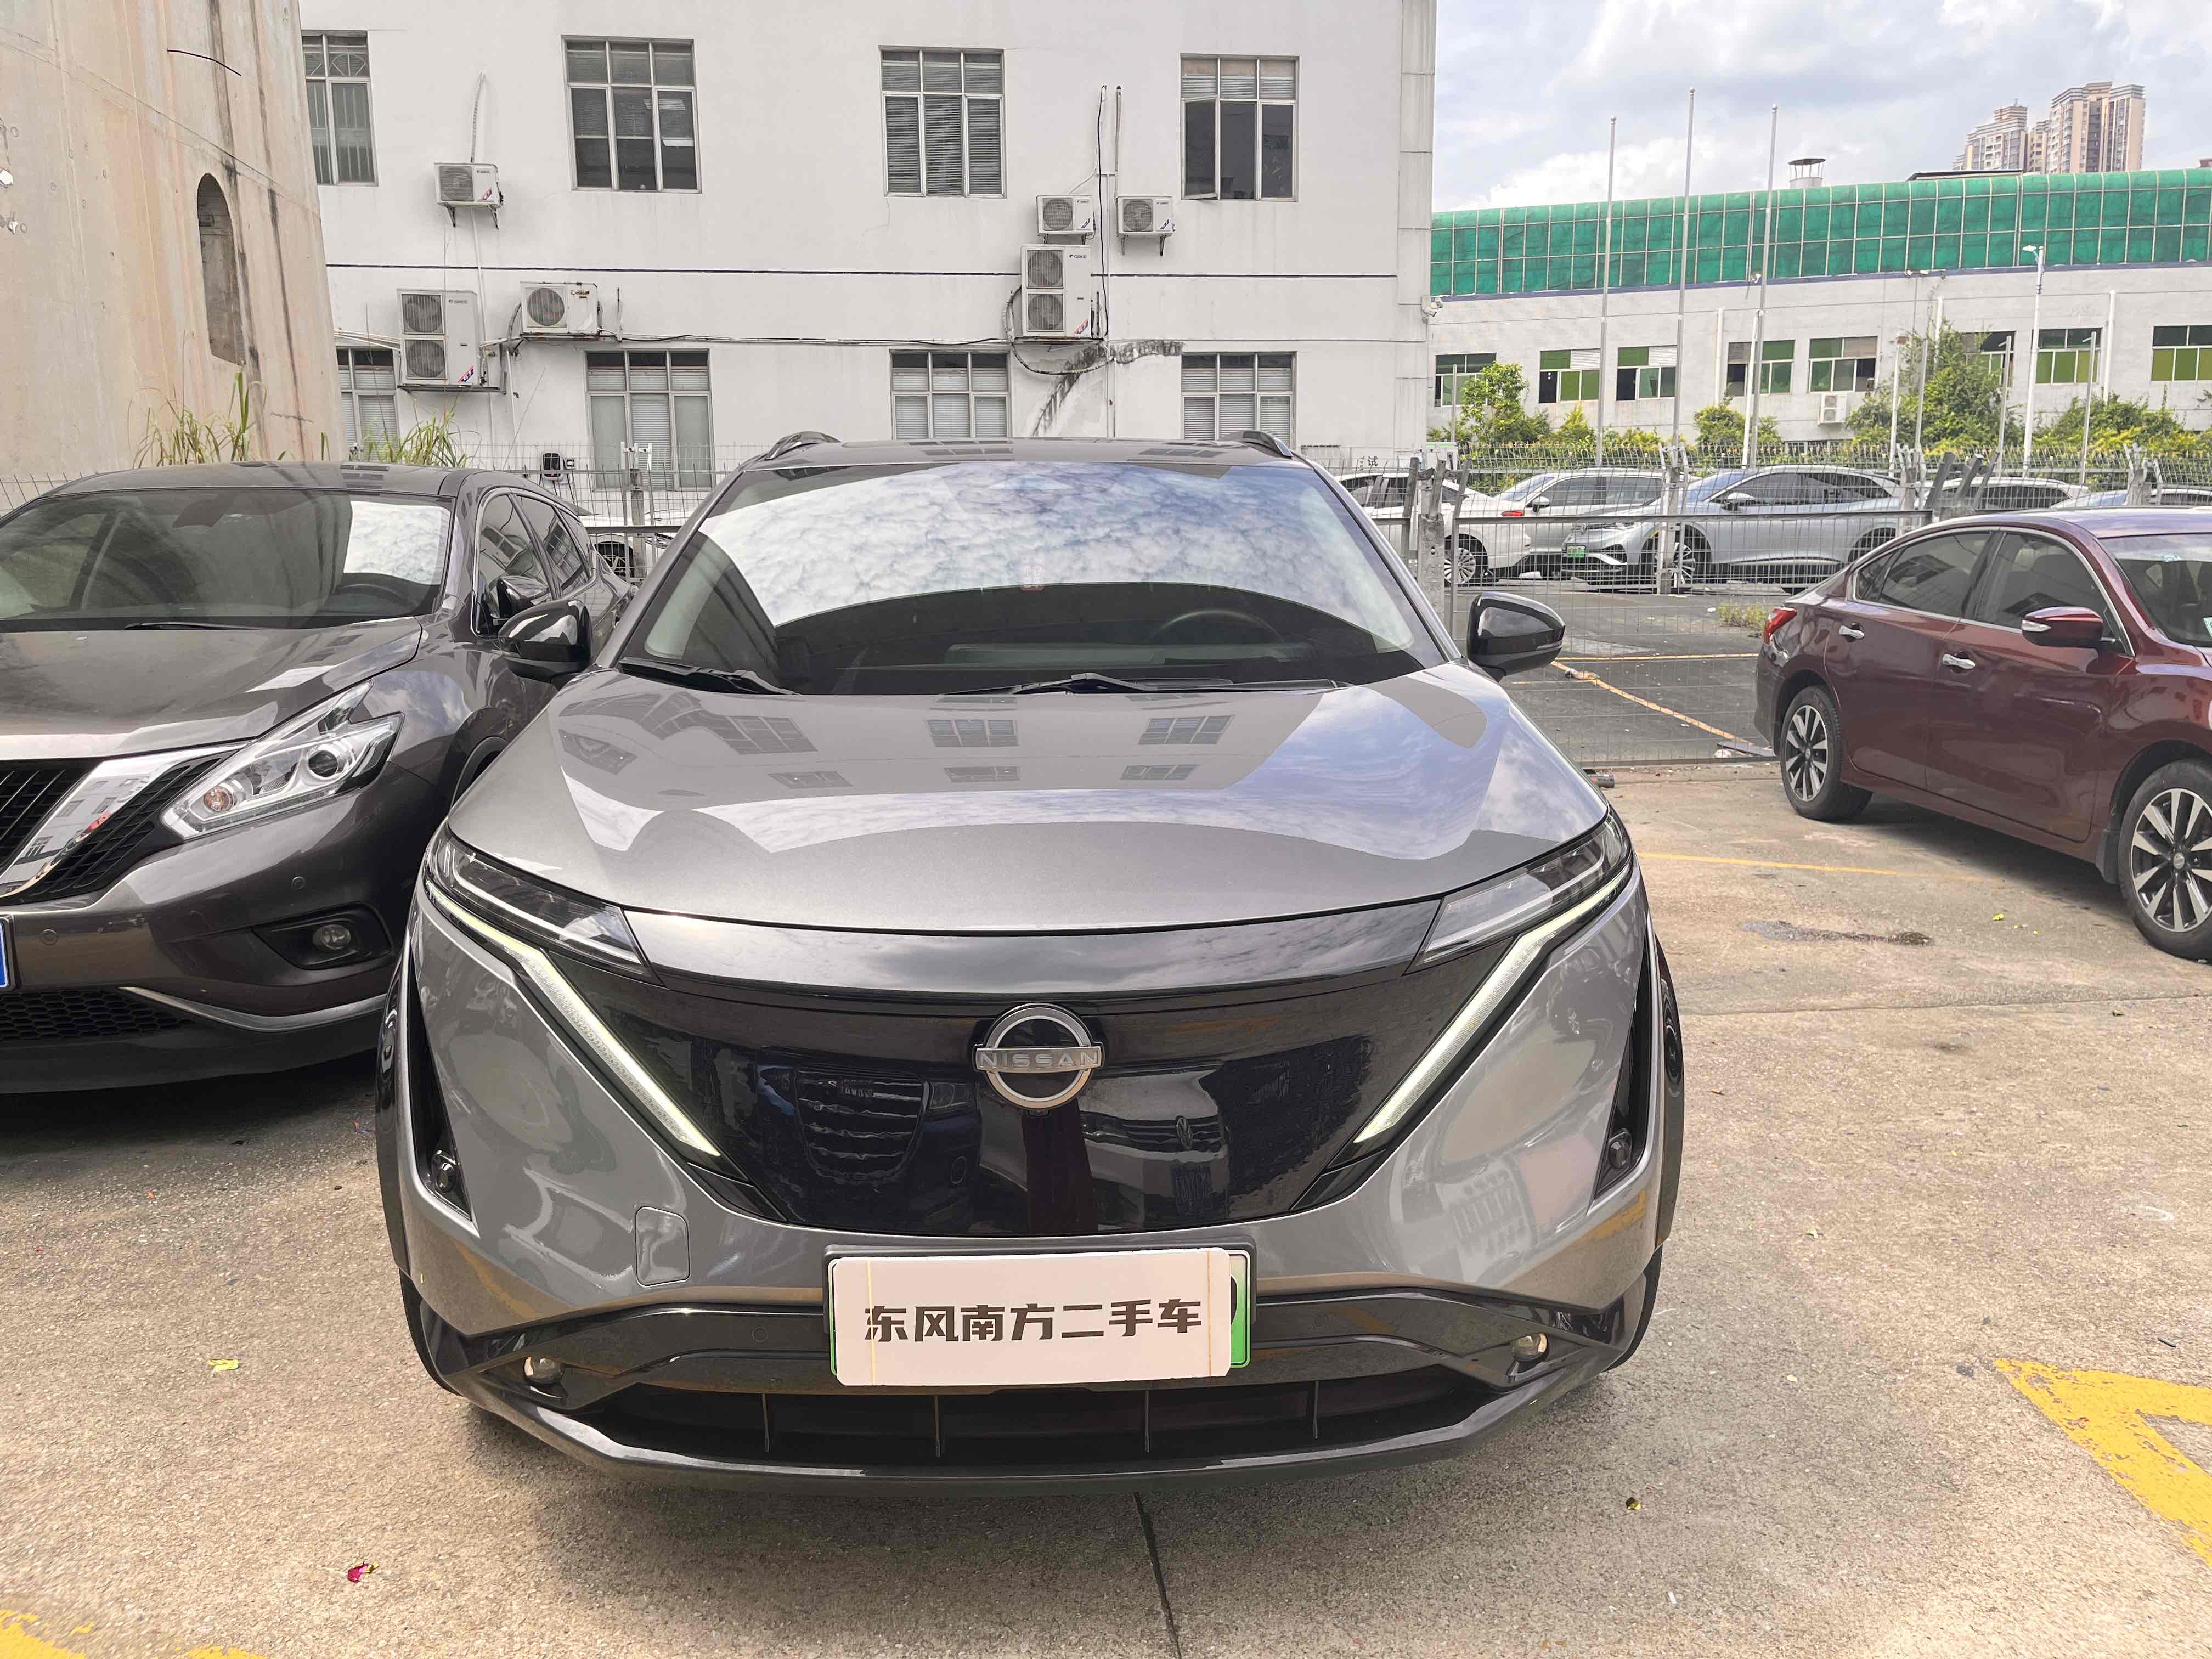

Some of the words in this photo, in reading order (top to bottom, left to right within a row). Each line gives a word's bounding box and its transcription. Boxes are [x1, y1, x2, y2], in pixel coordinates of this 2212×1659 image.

[981, 1052, 1098, 1070] NISSAN
[865, 1298, 1202, 1342] 东风南方二手车
